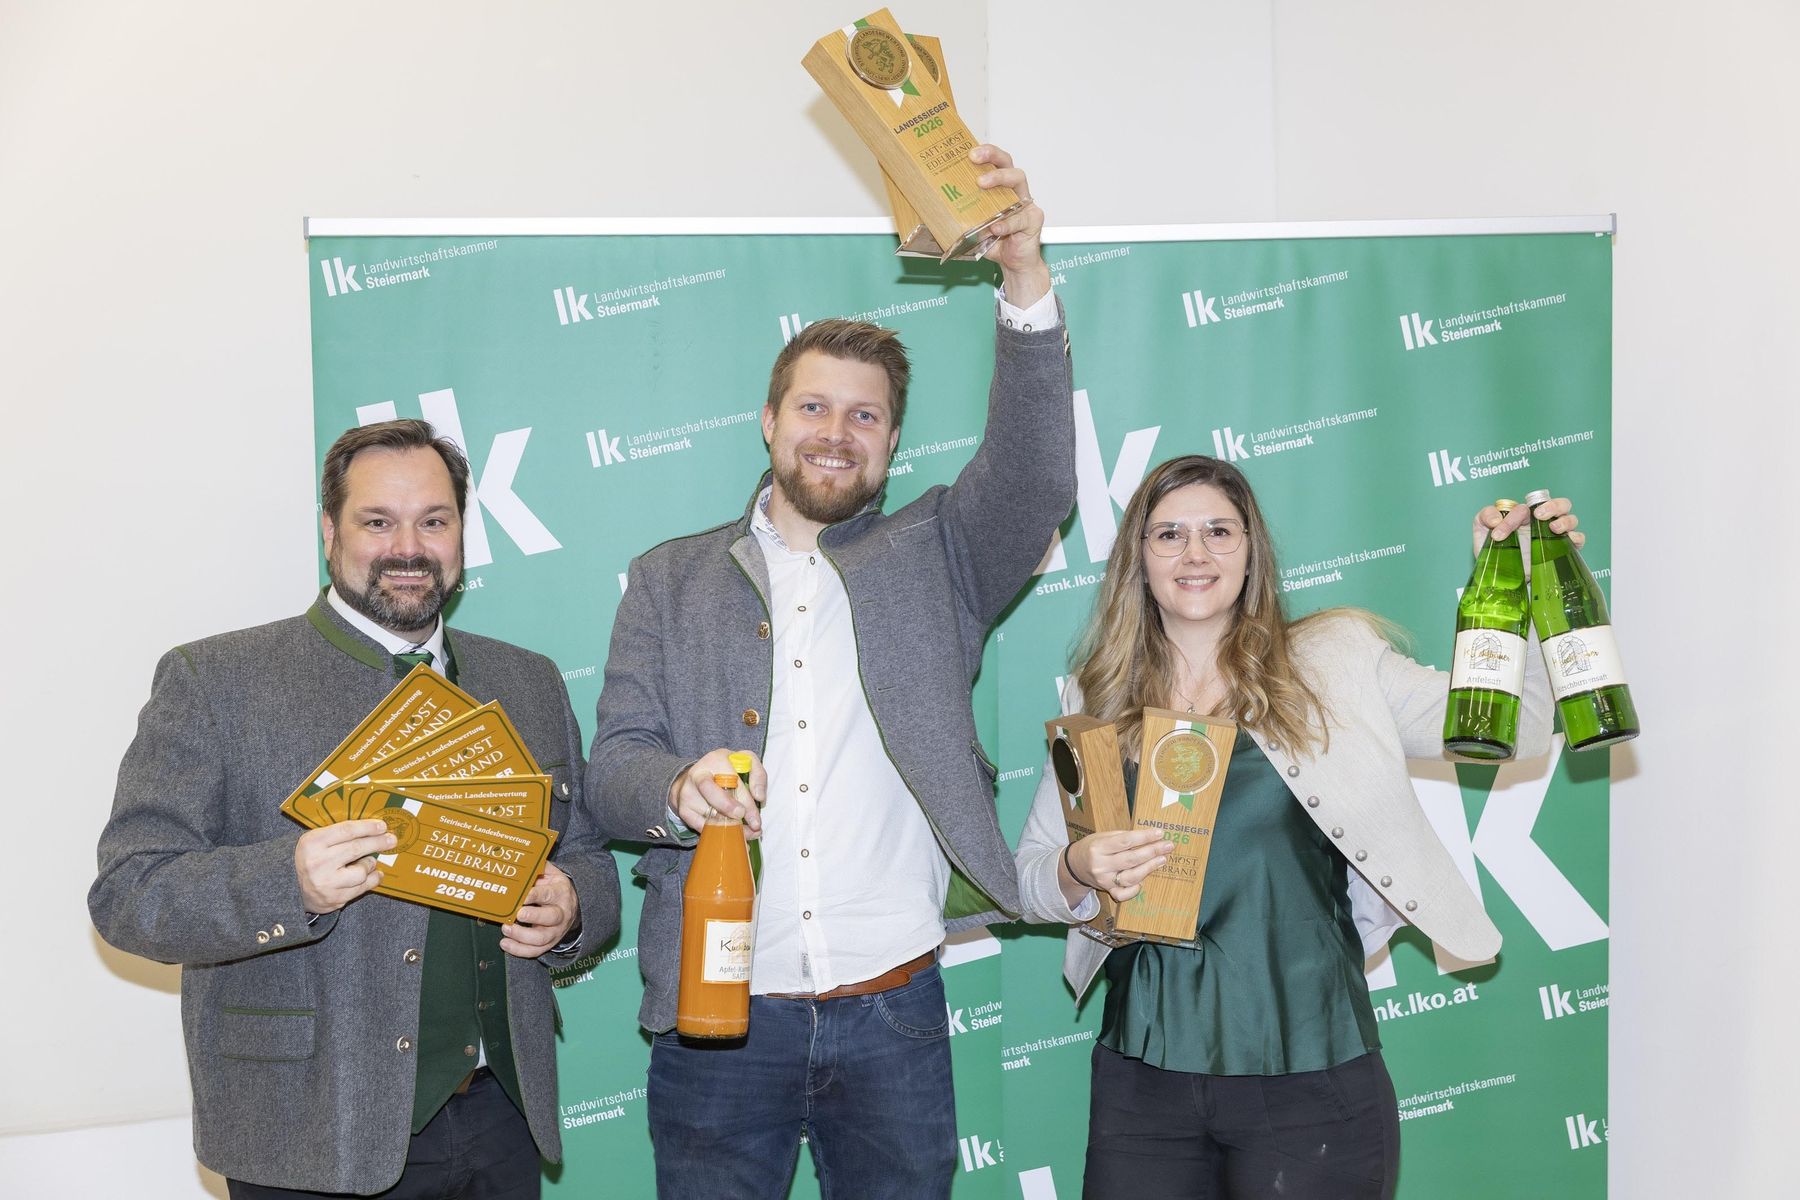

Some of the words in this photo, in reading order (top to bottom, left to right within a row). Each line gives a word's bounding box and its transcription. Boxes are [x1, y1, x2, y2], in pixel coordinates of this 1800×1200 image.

[894, 101, 949, 135] LANDESSIEGER
[913, 116, 944, 138] 2026
[919, 146, 941, 161] SAFT
[942, 131, 965, 151] MOST
[926, 141, 973, 170] EDELBRAND
[363, 239, 498, 275] Landwirtschaftskammer
[1050, 246, 1131, 272] schaftskammer
[321, 257, 363, 296] lk
[366, 266, 430, 290] Steiermark
[594, 267, 726, 304] Landwirtschaftskammer
[1221, 270, 1349, 306] Landwirtschaftskammer
[554, 286, 593, 325] lk
[597, 294, 660, 318] Steiermark
[1182, 289, 1221, 328] lk
[1223, 297, 1285, 320] Steiermark
[1439, 293, 1567, 329] Landwirtschaftskammer
[1400, 312, 1438, 351] lk
[1441, 320, 1502, 343] Steiermark
[626, 410, 758, 446] Landwirtschaftskammer
[1250, 407, 1378, 444] Landwirtschaftskammer
[586, 429, 626, 468] lk
[629, 438, 692, 461] Steiermark
[894, 435, 978, 462] tschaftskammer
[1212, 427, 1250, 462] lk
[1253, 434, 1314, 457] Steiermark
[1467, 429, 1594, 466] Landwirtschaftskammer
[1428, 449, 1467, 487] lk
[1469, 457, 1531, 480] Steiermark
[1280, 543, 1406, 579] Landwirtschaftskammer
[1036, 572, 1106, 595] stmk.lko.a
[1283, 570, 1343, 592] Steiermark
[349, 735, 377, 762] Steirische
[374, 689, 423, 736] Landesbewertung
[398, 698, 437, 738] MOST
[393, 754, 427, 776] Steirische
[426, 724, 486, 757] Landesbewertung
[448, 736, 494, 767] MOST
[464, 791, 527, 800] Landesbewertung
[440, 815, 472, 830] Steirische
[473, 824, 532, 846] Landesbewertung
[1137, 819, 1210, 835] LANDESSIEGER
[1163, 831, 1190, 844] 026
[423, 845, 517, 877] EDELBRAND
[430, 830, 471, 849] SAFT
[477, 843, 525, 863] MOST
[1168, 855, 1199, 867] MOST
[415, 864, 508, 895] LANDESSIEGER
[434, 884, 476, 902] 2026
[1539, 984, 1576, 1020] lk
[1001, 1030, 1093, 1057] irtschaftskammer
[1398, 1073, 1516, 1107] andwirtschaftskammer
[563, 1105, 625, 1129] Steiermark
[1565, 1113, 1602, 1150] lk
[959, 1134, 997, 1173] lk
